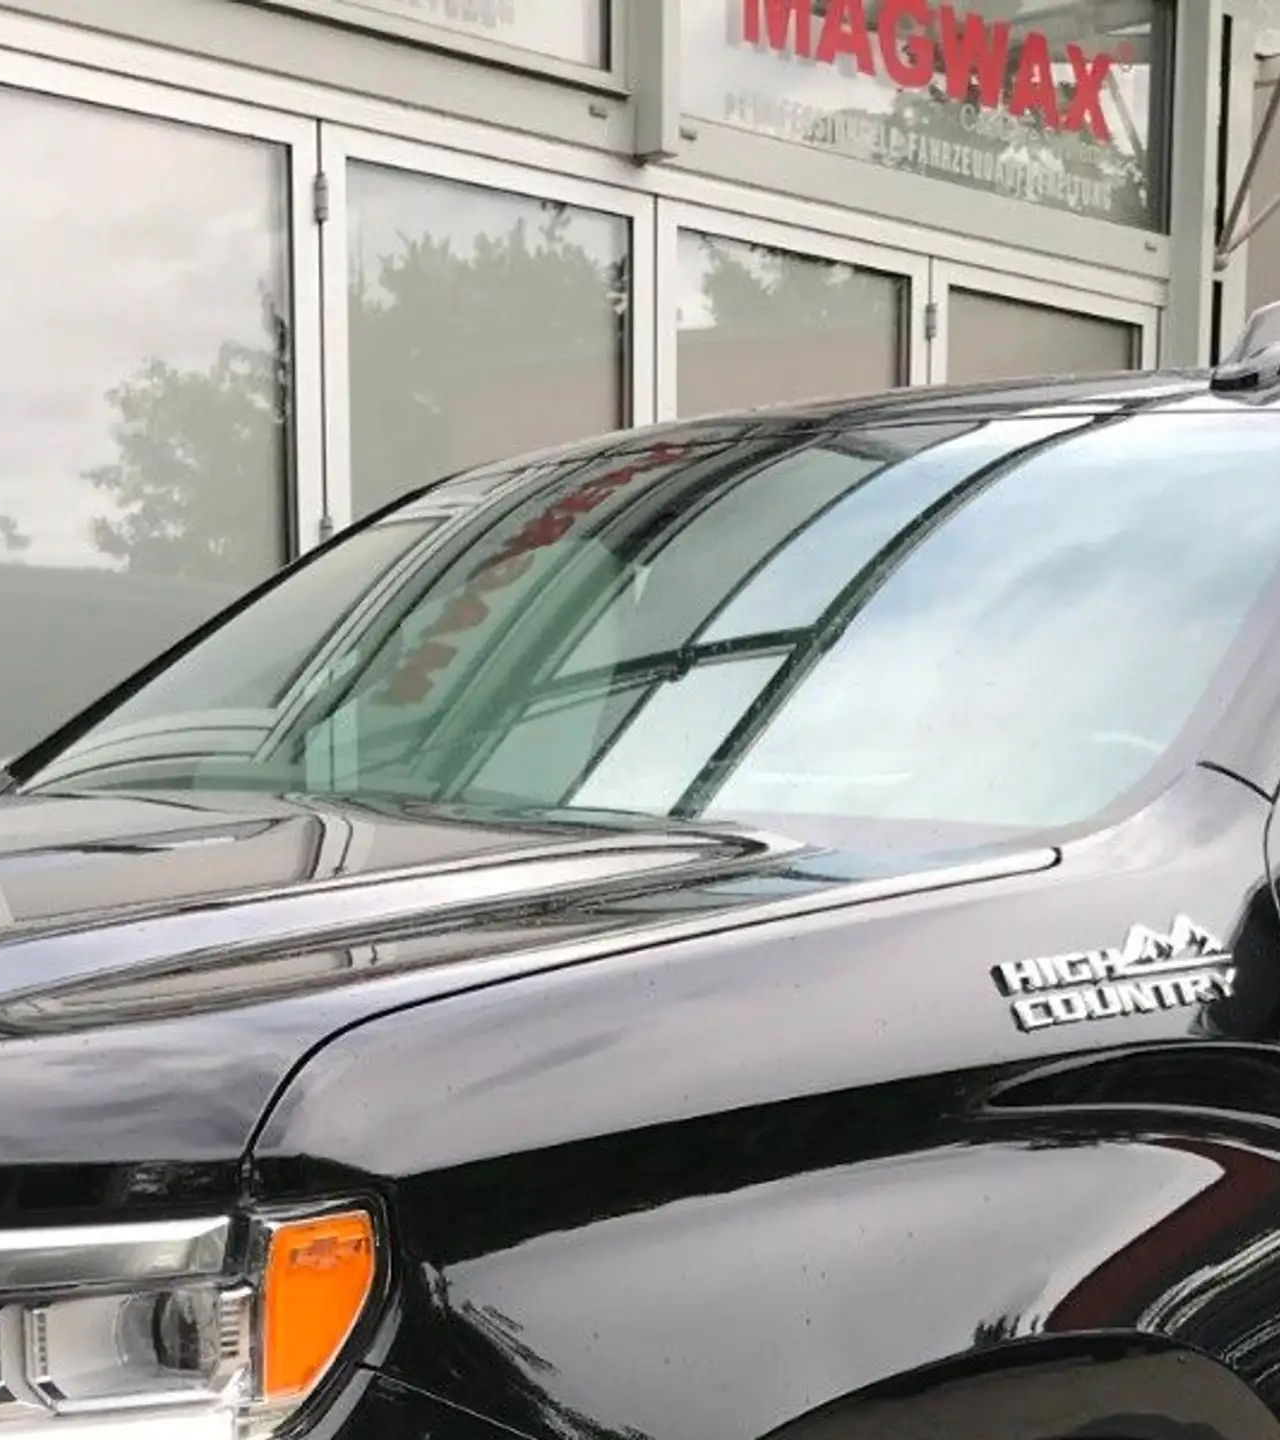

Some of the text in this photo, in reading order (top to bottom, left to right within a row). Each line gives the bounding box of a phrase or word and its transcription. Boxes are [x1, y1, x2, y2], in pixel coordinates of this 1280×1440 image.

[742, 0, 1114, 144] MAGWAX
[992, 948, 1122, 996] HIGH
[1010, 966, 1237, 1032] COUNTRY
